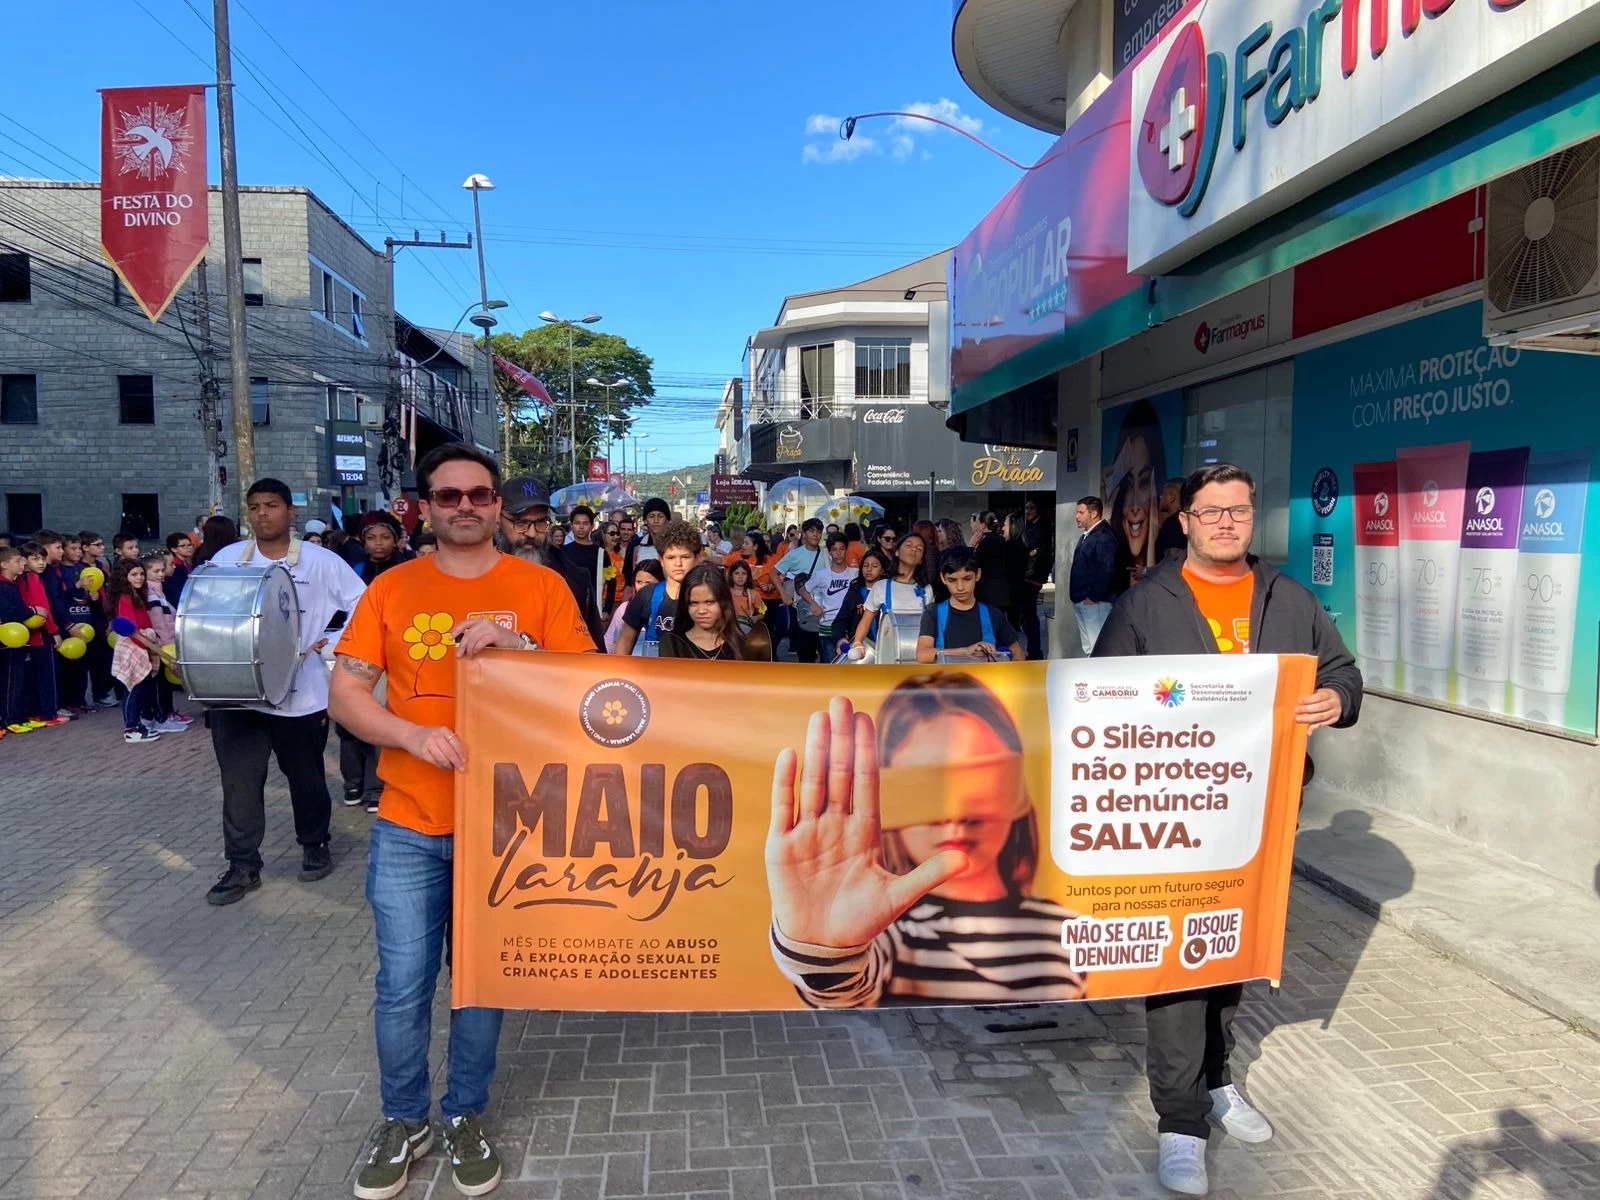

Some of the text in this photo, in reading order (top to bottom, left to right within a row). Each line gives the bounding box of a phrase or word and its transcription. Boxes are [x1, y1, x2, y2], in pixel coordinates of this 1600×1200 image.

[113, 193, 193, 210] FESTA DO
[124, 211, 181, 227] DIVINO
[987, 216, 1072, 318] POPULAR
[1210, 313, 1265, 346] Farmagnus
[1349, 363, 1416, 398] MÁXIMA
[1352, 378, 1514, 428] COM PREÇO JUSTO.
[972, 457, 1044, 486] Praça
[1366, 520, 1394, 530] ANASOL
[1412, 510, 1446, 524] ANASOL
[1466, 518, 1504, 531] ANASOL
[1522, 522, 1564, 536] ANASOL
[1368, 562, 1388, 586] 50
[1416, 558, 1436, 585] 70
[1472, 568, 1492, 594] 75
[830, 580, 850, 588] NIKE
[1528, 574, 1554, 602] 90
[495, 620, 512, 630] 00
[584, 681, 620, 707] MAIO LARANJA
[1092, 688, 1138, 696] CAMBORIÚ
[1071, 723, 1216, 749] O Silêncio
[1071, 756, 1253, 786] não protege,
[492, 762, 734, 860] MAIO
[1070, 786, 1228, 812] a denúncia
[1070, 822, 1202, 852] SALVA.
[1066, 877, 1244, 898] Juntos por um futuro seguro
[1092, 894, 1221, 914] para nossas crianças.
[1066, 920, 1168, 945] NÃO SE CALE,
[1187, 913, 1239, 937] DISQUE
[503, 935, 718, 949] MÊS DE COMBATE AO ABUSO
[1209, 934, 1236, 955] 100
[500, 950, 720, 966] E À EXPLORAÇÃO SEXUAL DE
[1075, 943, 1159, 967] DENUNCIE!
[502, 967, 718, 980] CRIANÇAS E ADOLESCENTES
